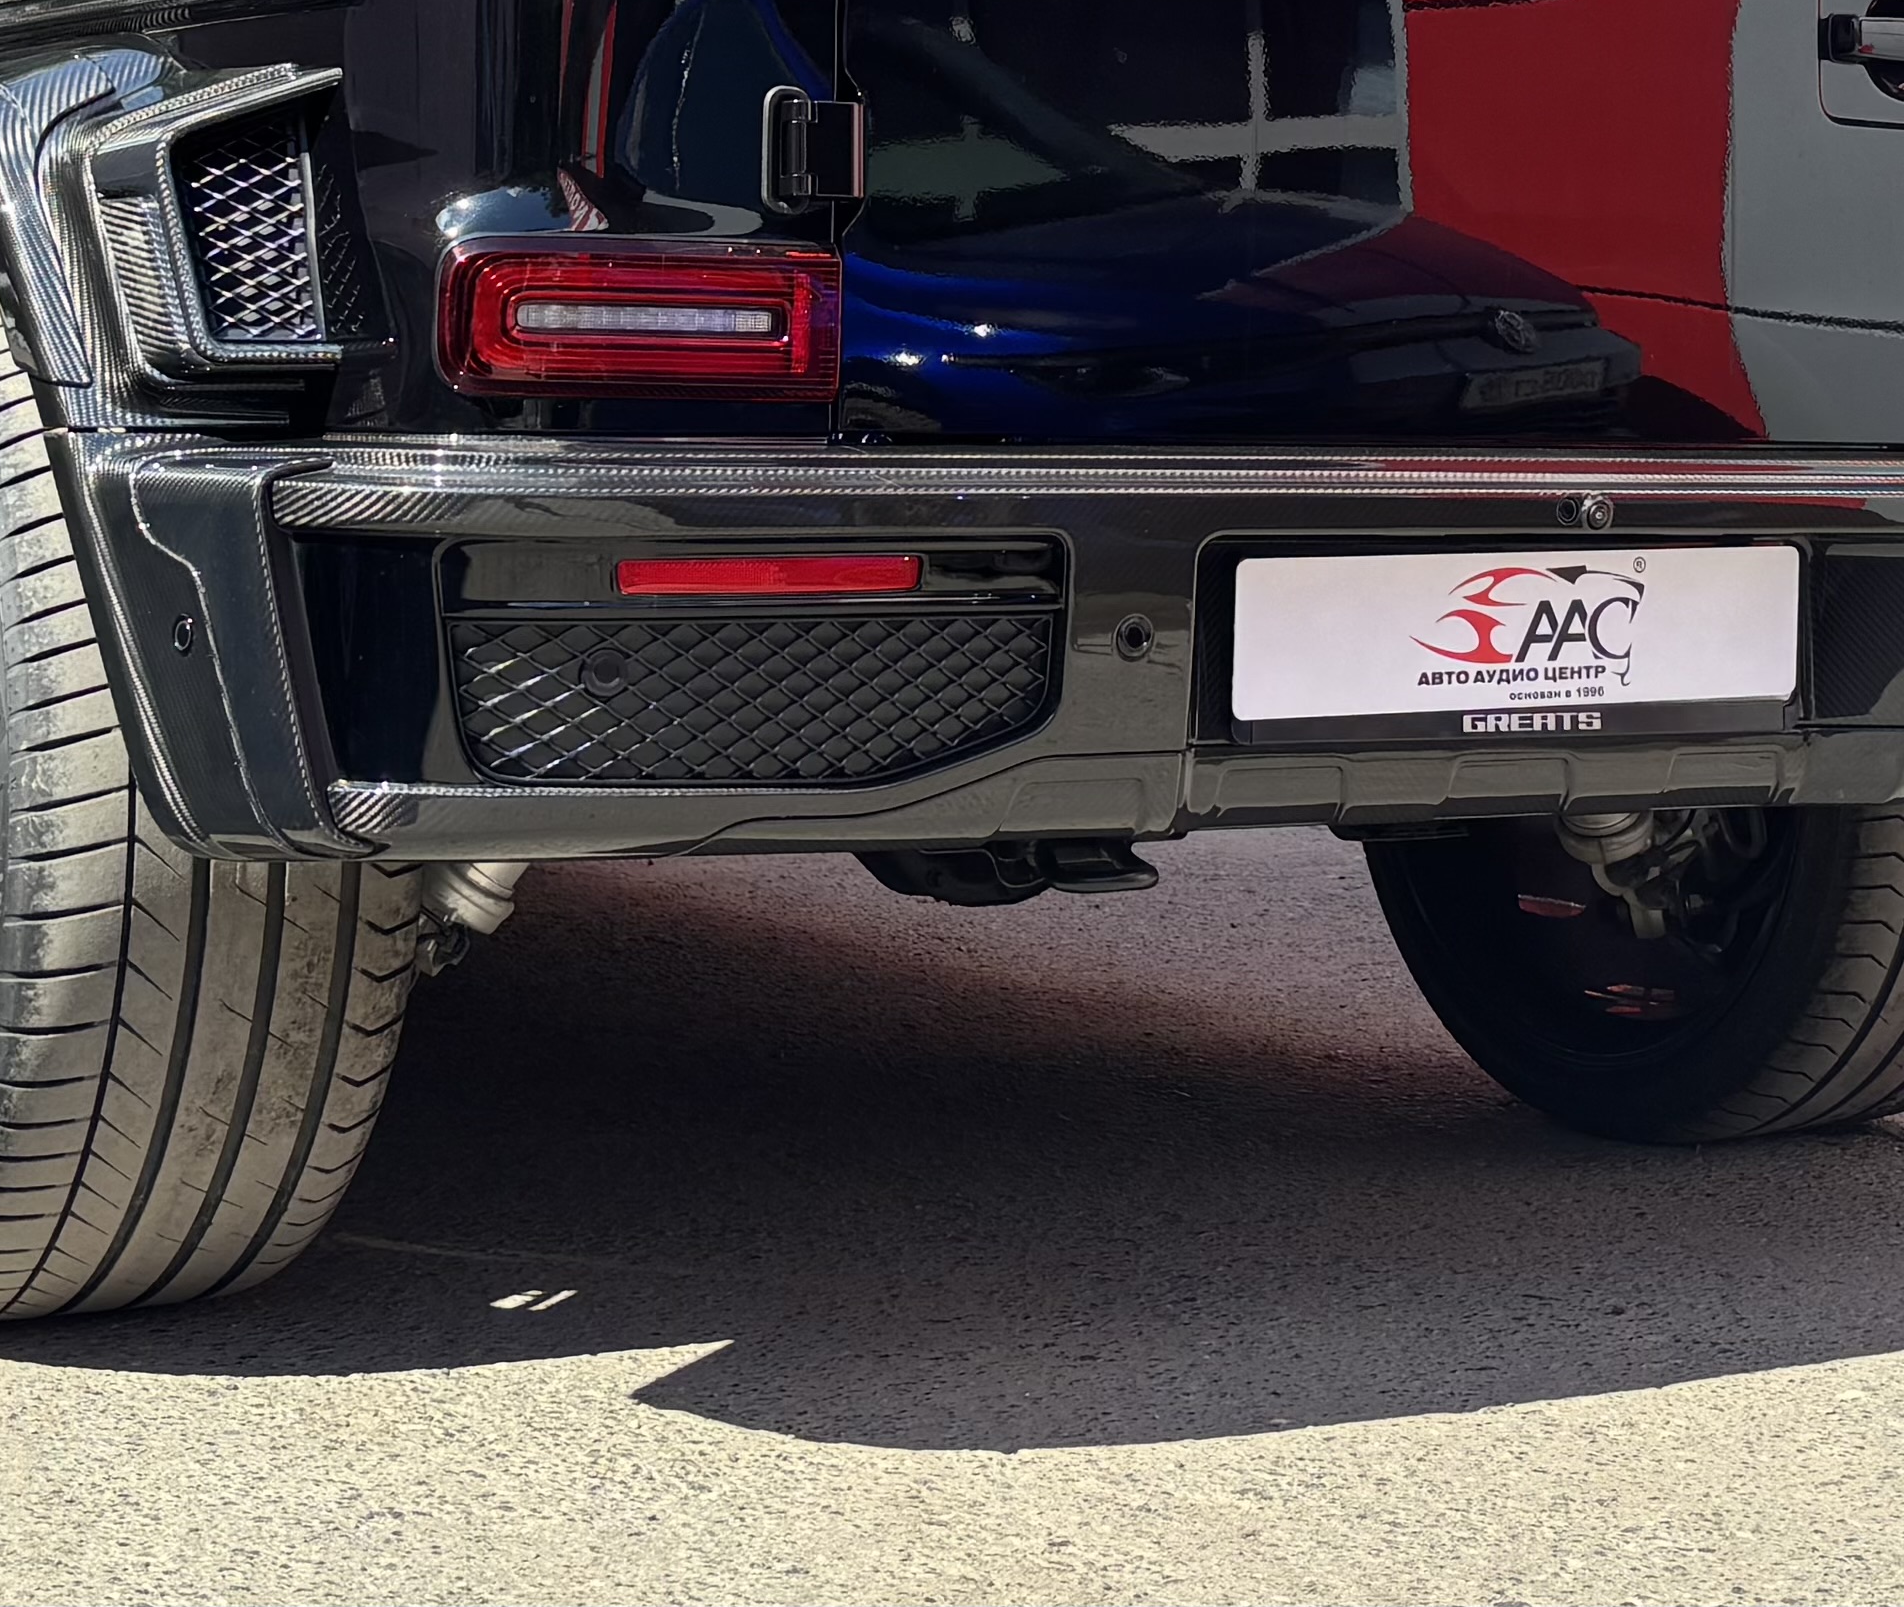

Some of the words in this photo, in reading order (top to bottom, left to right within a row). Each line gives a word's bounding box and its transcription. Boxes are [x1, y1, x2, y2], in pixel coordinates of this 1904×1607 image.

[1417, 670, 1469, 686] АВТО
[1473, 667, 1539, 685] АУДИО
[1544, 664, 1606, 683] ЦЕНТР
[1576, 686, 1605, 698] 1996
[1462, 711, 1603, 733] GREATS
